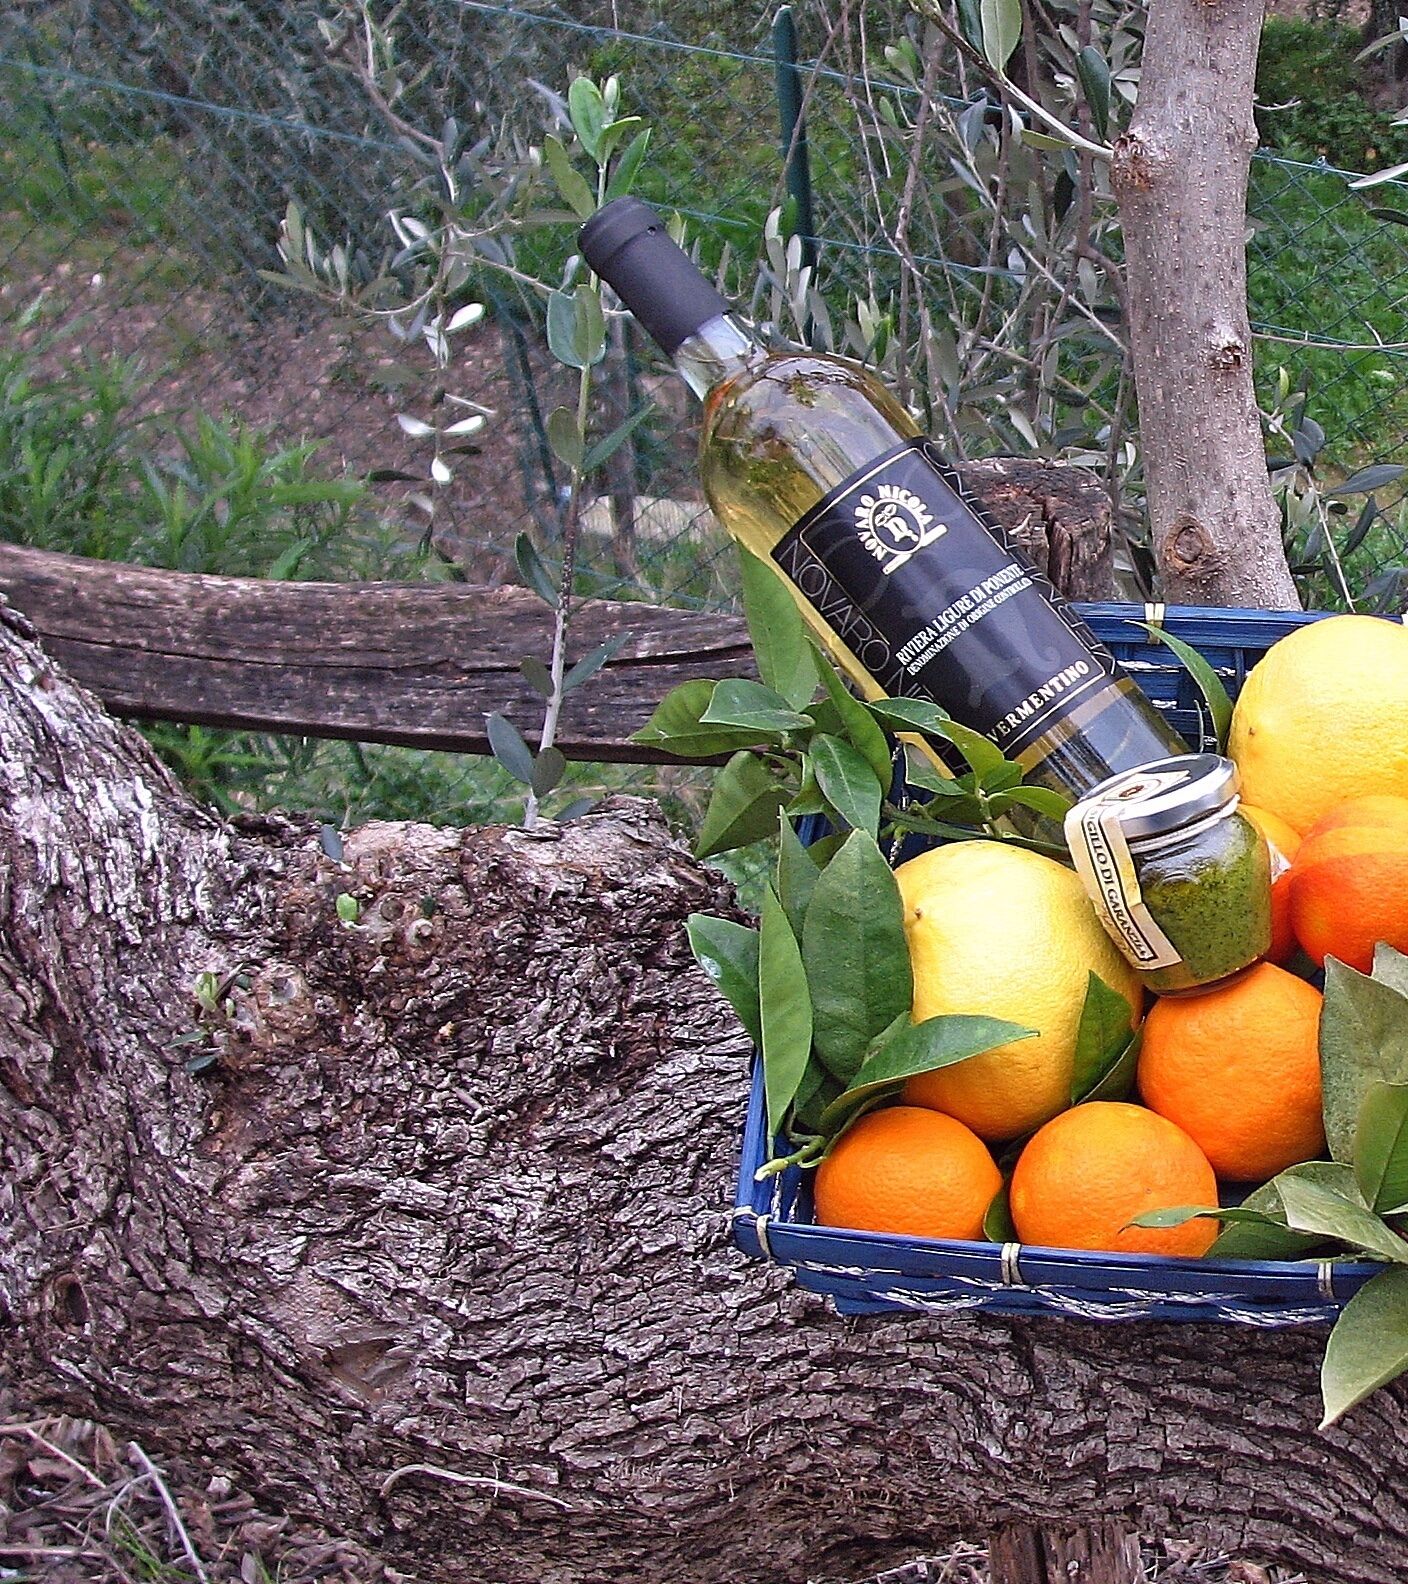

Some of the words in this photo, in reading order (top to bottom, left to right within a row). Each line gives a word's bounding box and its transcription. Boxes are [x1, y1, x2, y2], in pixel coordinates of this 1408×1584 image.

[854, 494, 888, 561] NOVARO
[877, 484, 934, 525] NICOLA
[777, 538, 890, 672] NOVARO
[895, 626, 939, 666] RIVIERA
[931, 594, 975, 632] LIGURE
[968, 585, 989, 603] DI
[980, 562, 1025, 595] PONENTE
[906, 625, 961, 676] DENOMINAZIONE
[956, 616, 970, 632] DI
[966, 598, 997, 624] ORIGINE
[985, 660, 1090, 743] VERMENTINO
[1087, 810, 1108, 865] SIGILLO
[1101, 868, 1114, 885] DI
[1107, 888, 1148, 956] GARANZIA
